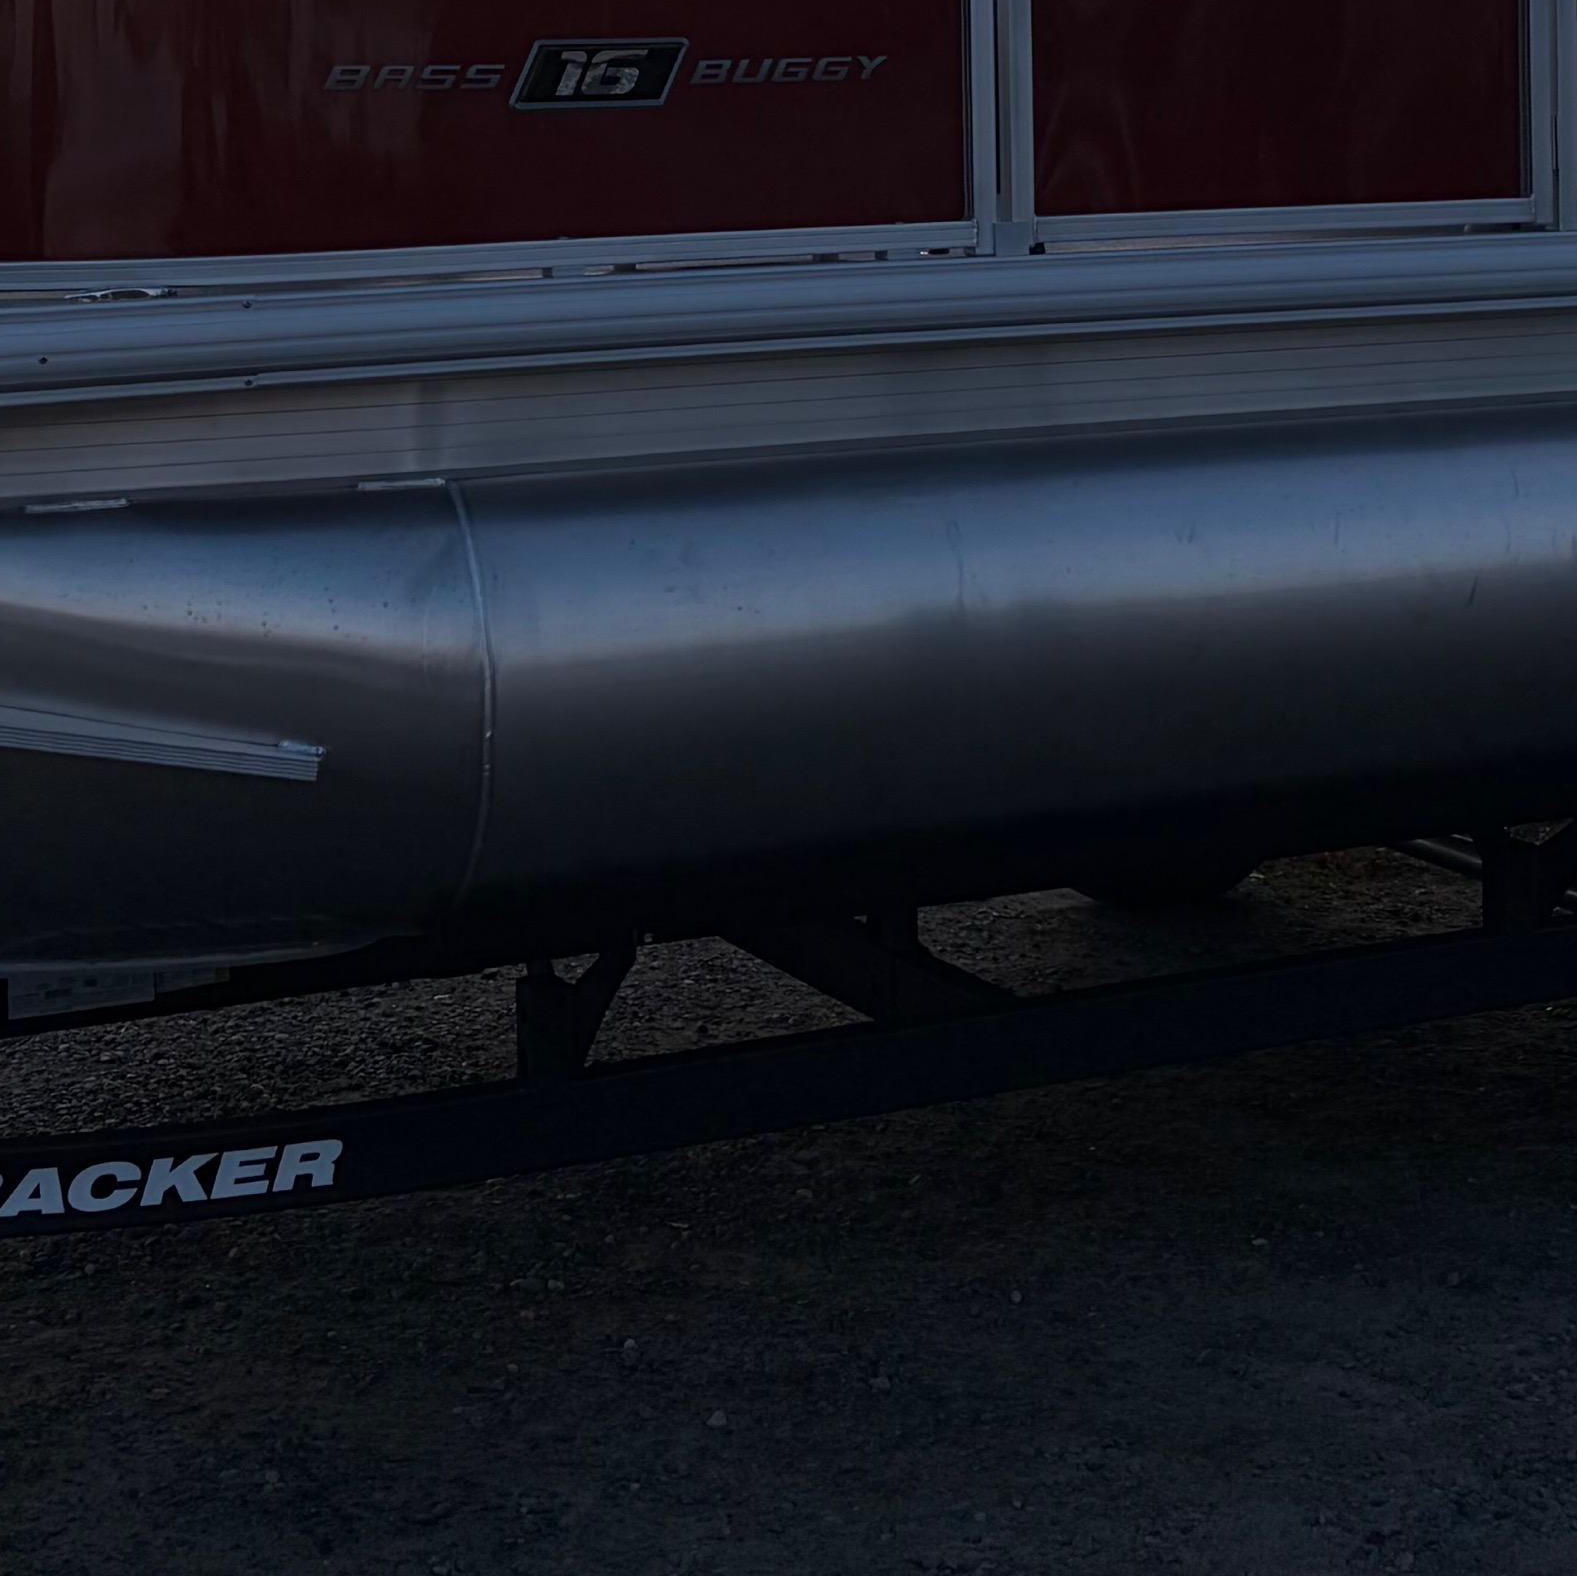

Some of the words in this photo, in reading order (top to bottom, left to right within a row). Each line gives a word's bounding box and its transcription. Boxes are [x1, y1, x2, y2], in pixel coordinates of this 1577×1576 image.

[324, 63, 506, 91] BASS
[552, 48, 649, 97] 16
[689, 54, 889, 86] BUGGY
